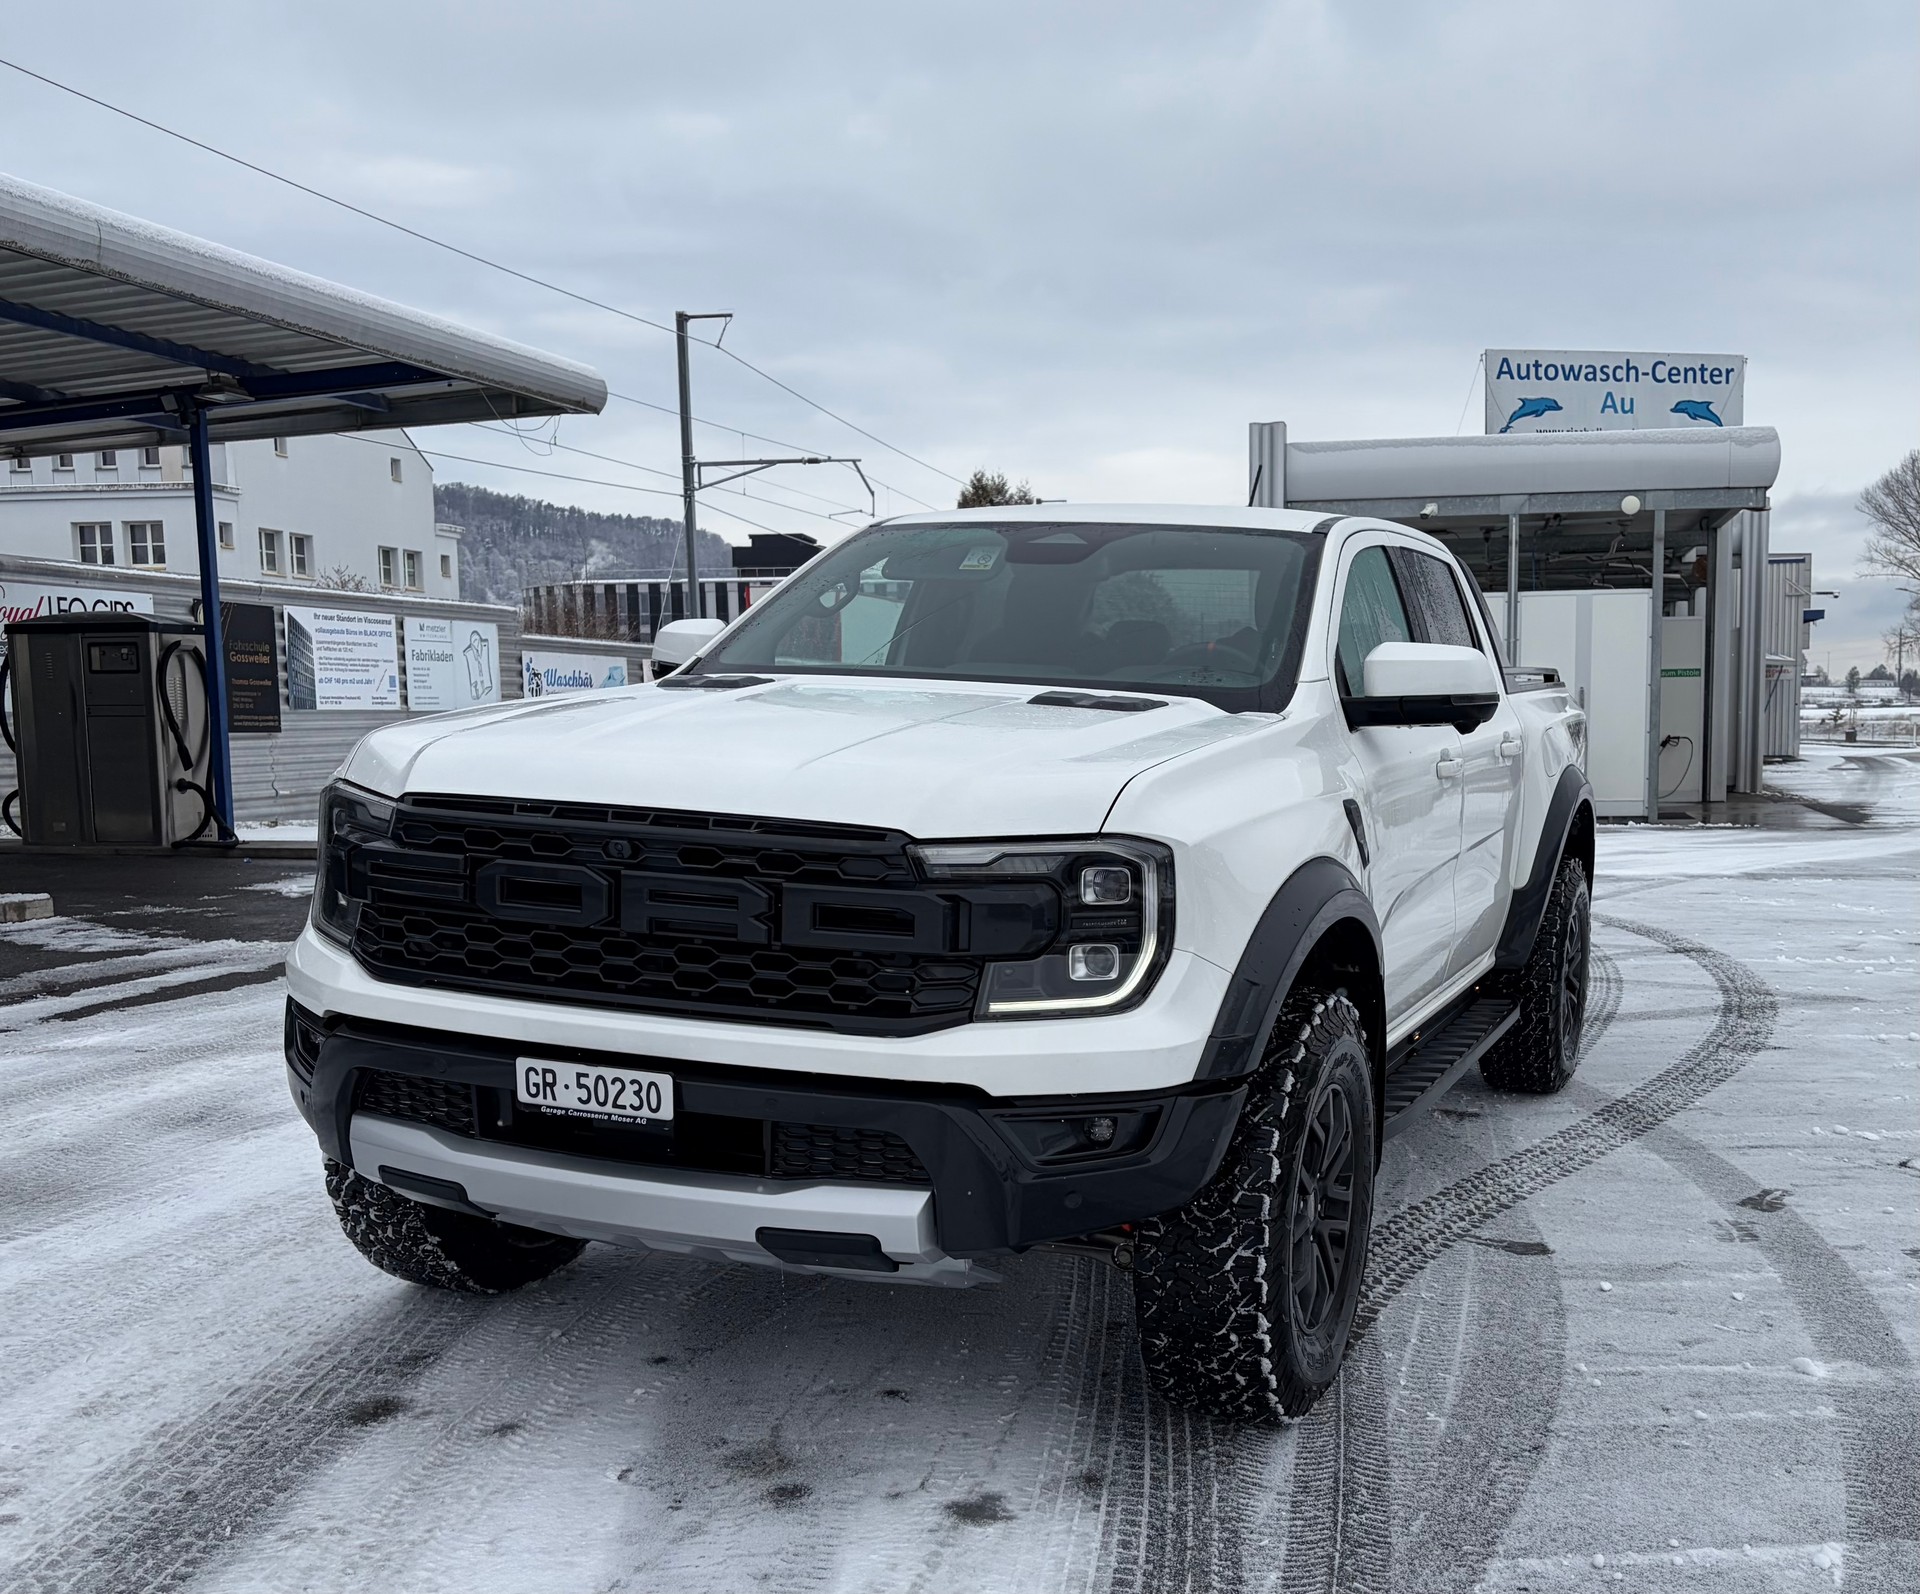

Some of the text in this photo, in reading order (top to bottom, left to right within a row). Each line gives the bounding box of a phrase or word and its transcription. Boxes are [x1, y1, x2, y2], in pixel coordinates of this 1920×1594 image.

[1496, 357, 1735, 385] Autowasch-Center
[1600, 391, 1635, 415] Au
[336, 613, 357, 623] Standort
[378, 630, 393, 638] OFFICE
[228, 639, 270, 653] Fahrschule
[229, 651, 270, 664] Gossweiler
[411, 649, 454, 662] Fabrikladen
[543, 668, 594, 688] Waschbär
[540, 1105, 647, 1125] Garage Carrosserie Moser AG
